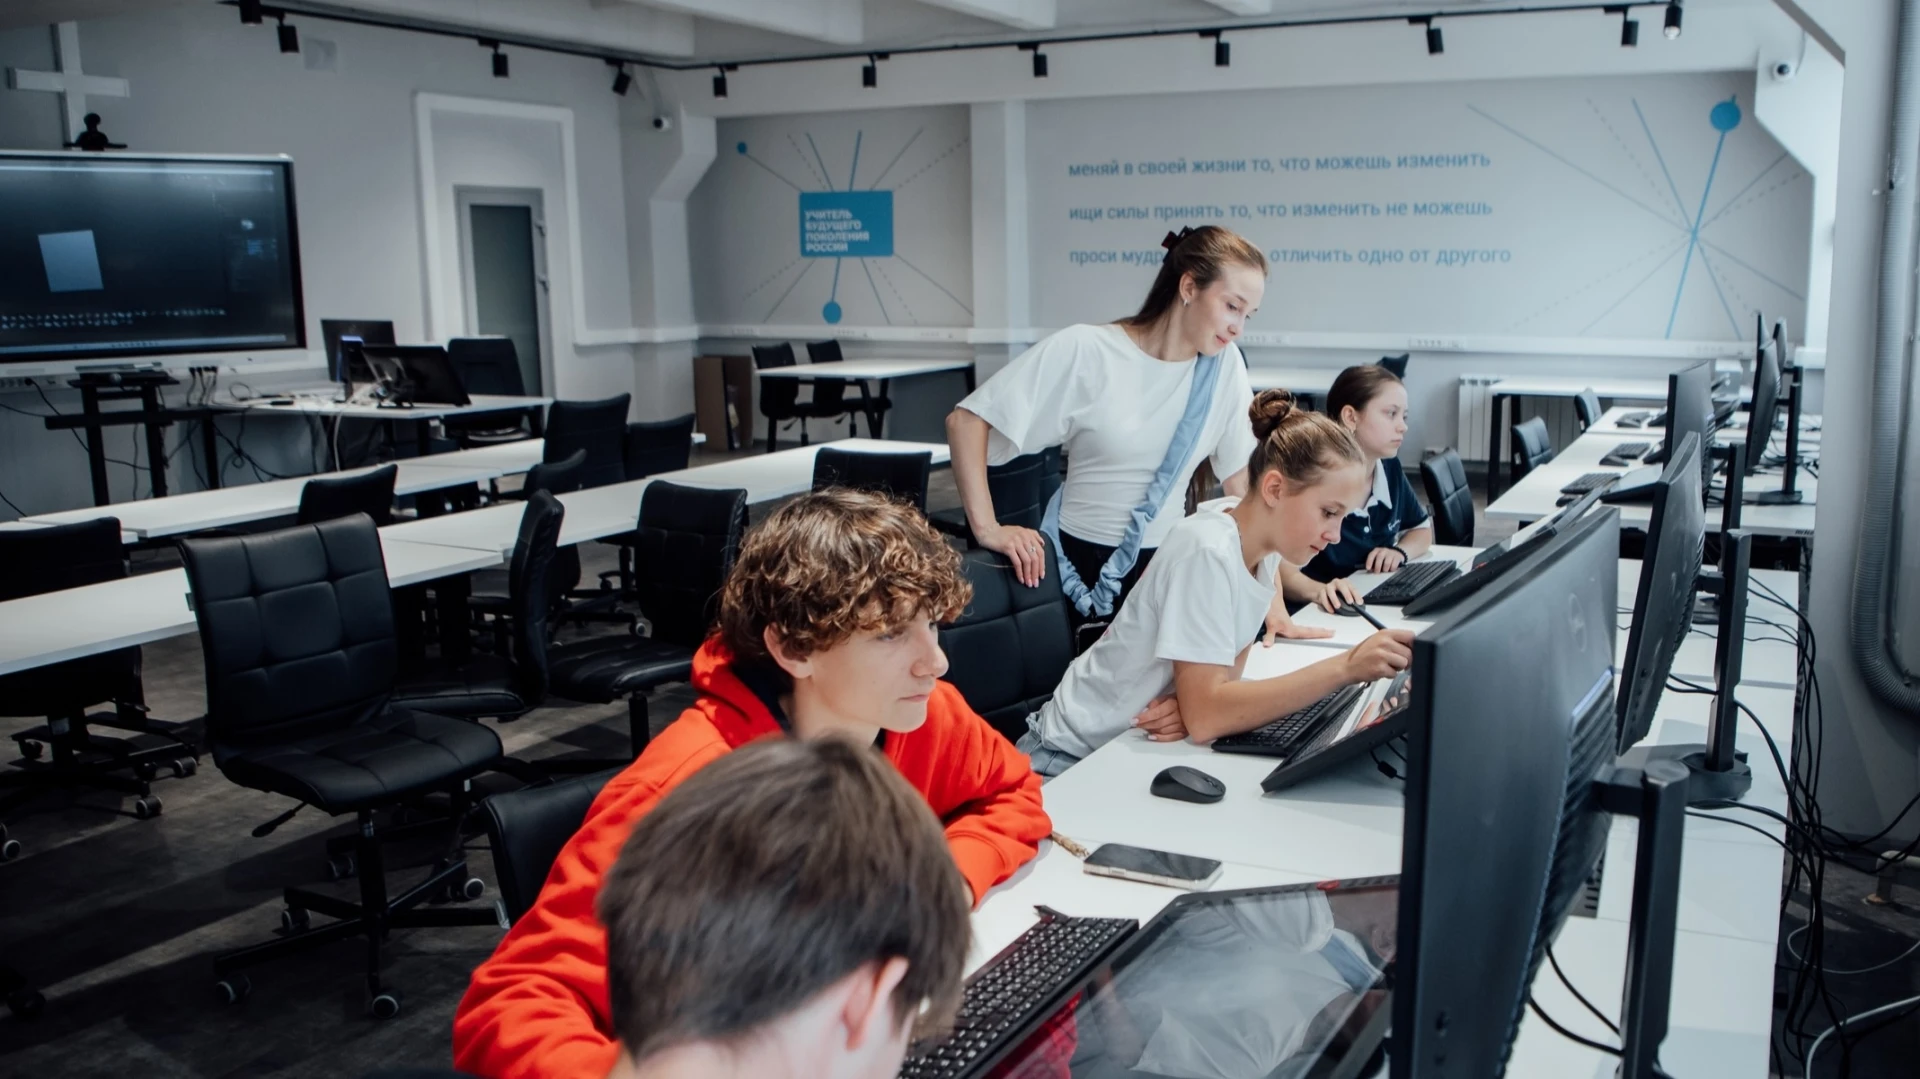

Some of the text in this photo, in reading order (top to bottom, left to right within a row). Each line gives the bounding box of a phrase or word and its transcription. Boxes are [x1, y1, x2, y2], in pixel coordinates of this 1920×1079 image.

[1069, 153, 1491, 176] меняй в своей жизни то, что можешь изменить
[805, 209, 853, 220] УЧИТЕЛЬ
[1069, 201, 1493, 222] ищи силы принять то, что изменить не можешь
[805, 220, 862, 231] БУДУЩЕГО
[805, 231, 870, 242] ПОКОЛЕНИЯ
[806, 242, 848, 252] РОССИИ
[1070, 248, 1511, 267] проси мудр отличить одно от другого
